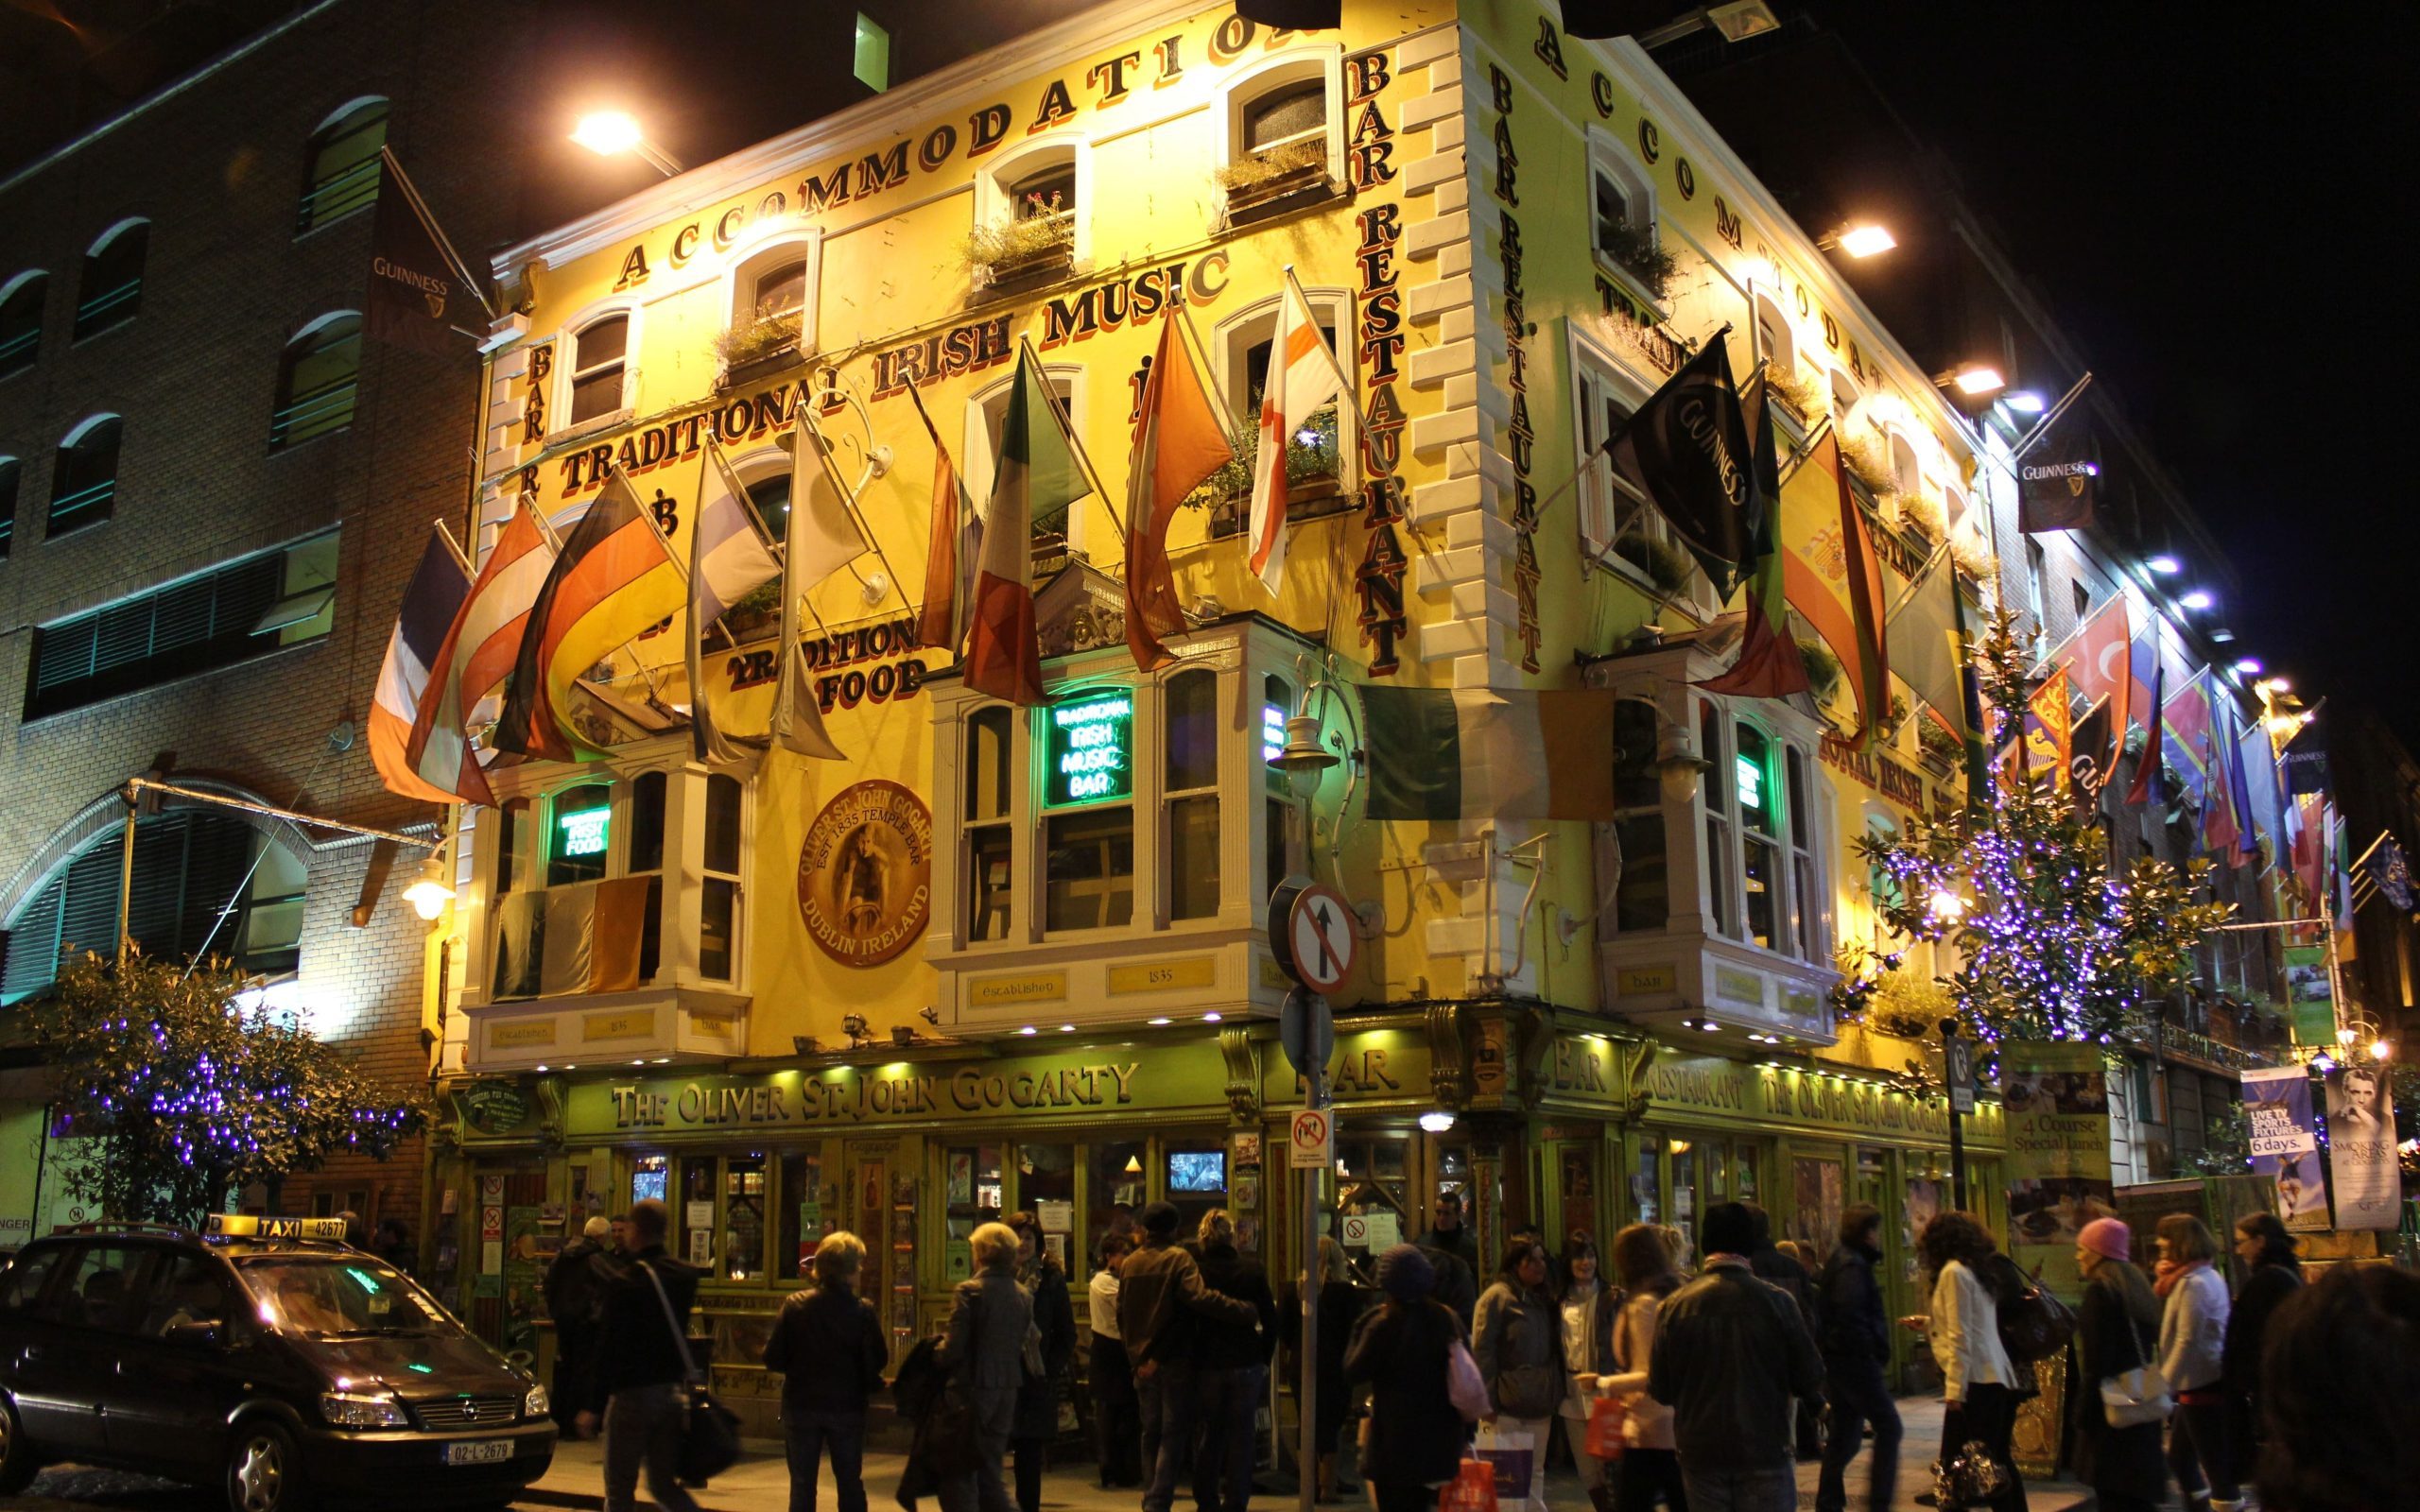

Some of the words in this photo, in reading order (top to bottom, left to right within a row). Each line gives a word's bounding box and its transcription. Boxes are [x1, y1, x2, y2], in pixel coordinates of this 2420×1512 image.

[1347, 52, 1398, 194] BAR
[1488, 62, 1520, 208] BAR
[613, 11, 1318, 293] ACCOMMODATIO
[373, 256, 448, 296] GUINNESS
[560, 376, 856, 499] TRADITIONAL
[870, 313, 1016, 404] IRISH
[1040, 248, 1233, 352] MUSIC
[527, 344, 554, 446] BAR
[1355, 202, 1409, 679] RESTAURANT
[1498, 207, 1543, 677] RESTAURANT
[1679, 398, 1748, 507] GUINNESS
[2022, 460, 2087, 481] GUINNESS
[726, 616, 919, 693] TRDITION
[813, 659, 927, 715] FOOD
[1070, 722, 1114, 748] IRISH
[1061, 745, 1120, 773] MUSIC
[833, 796, 851, 820] ST
[853, 788, 893, 812] JOHN
[1070, 771, 1109, 798] BAR
[566, 836, 603, 856] FOOD
[816, 838, 834, 870] EST
[833, 814, 860, 840] 1835
[861, 808, 907, 836] TEMPLE
[905, 833, 920, 868] BAR
[803, 896, 856, 955] DUBLIN
[861, 884, 929, 956] IRELAND
[1149, 970, 1173, 984] 1835
[1554, 1039, 1606, 1093] BAR
[612, 1085, 667, 1128] THE
[678, 1081, 791, 1125] OLIVER
[853, 1074, 938, 1121] JOHN
[951, 1062, 1142, 1111] GOGARTY
[1762, 1074, 1793, 1117] THE
[2250, 1109, 2273, 1121] LIVE
[2274, 1108, 2289, 1119] TV
[2038, 1114, 2098, 1134] Course
[2252, 1117, 2292, 1129] SPORTS
[2253, 1125, 2304, 1138] FIXTURES
[2014, 1136, 2065, 1155] Special
[2066, 1137, 2104, 1152] Lunch
[2253, 1139, 2262, 1152] 6
[2333, 1140, 2390, 1152] SMOKING
[261, 1219, 301, 1237] TAXI
[315, 1220, 346, 1237] 42677
